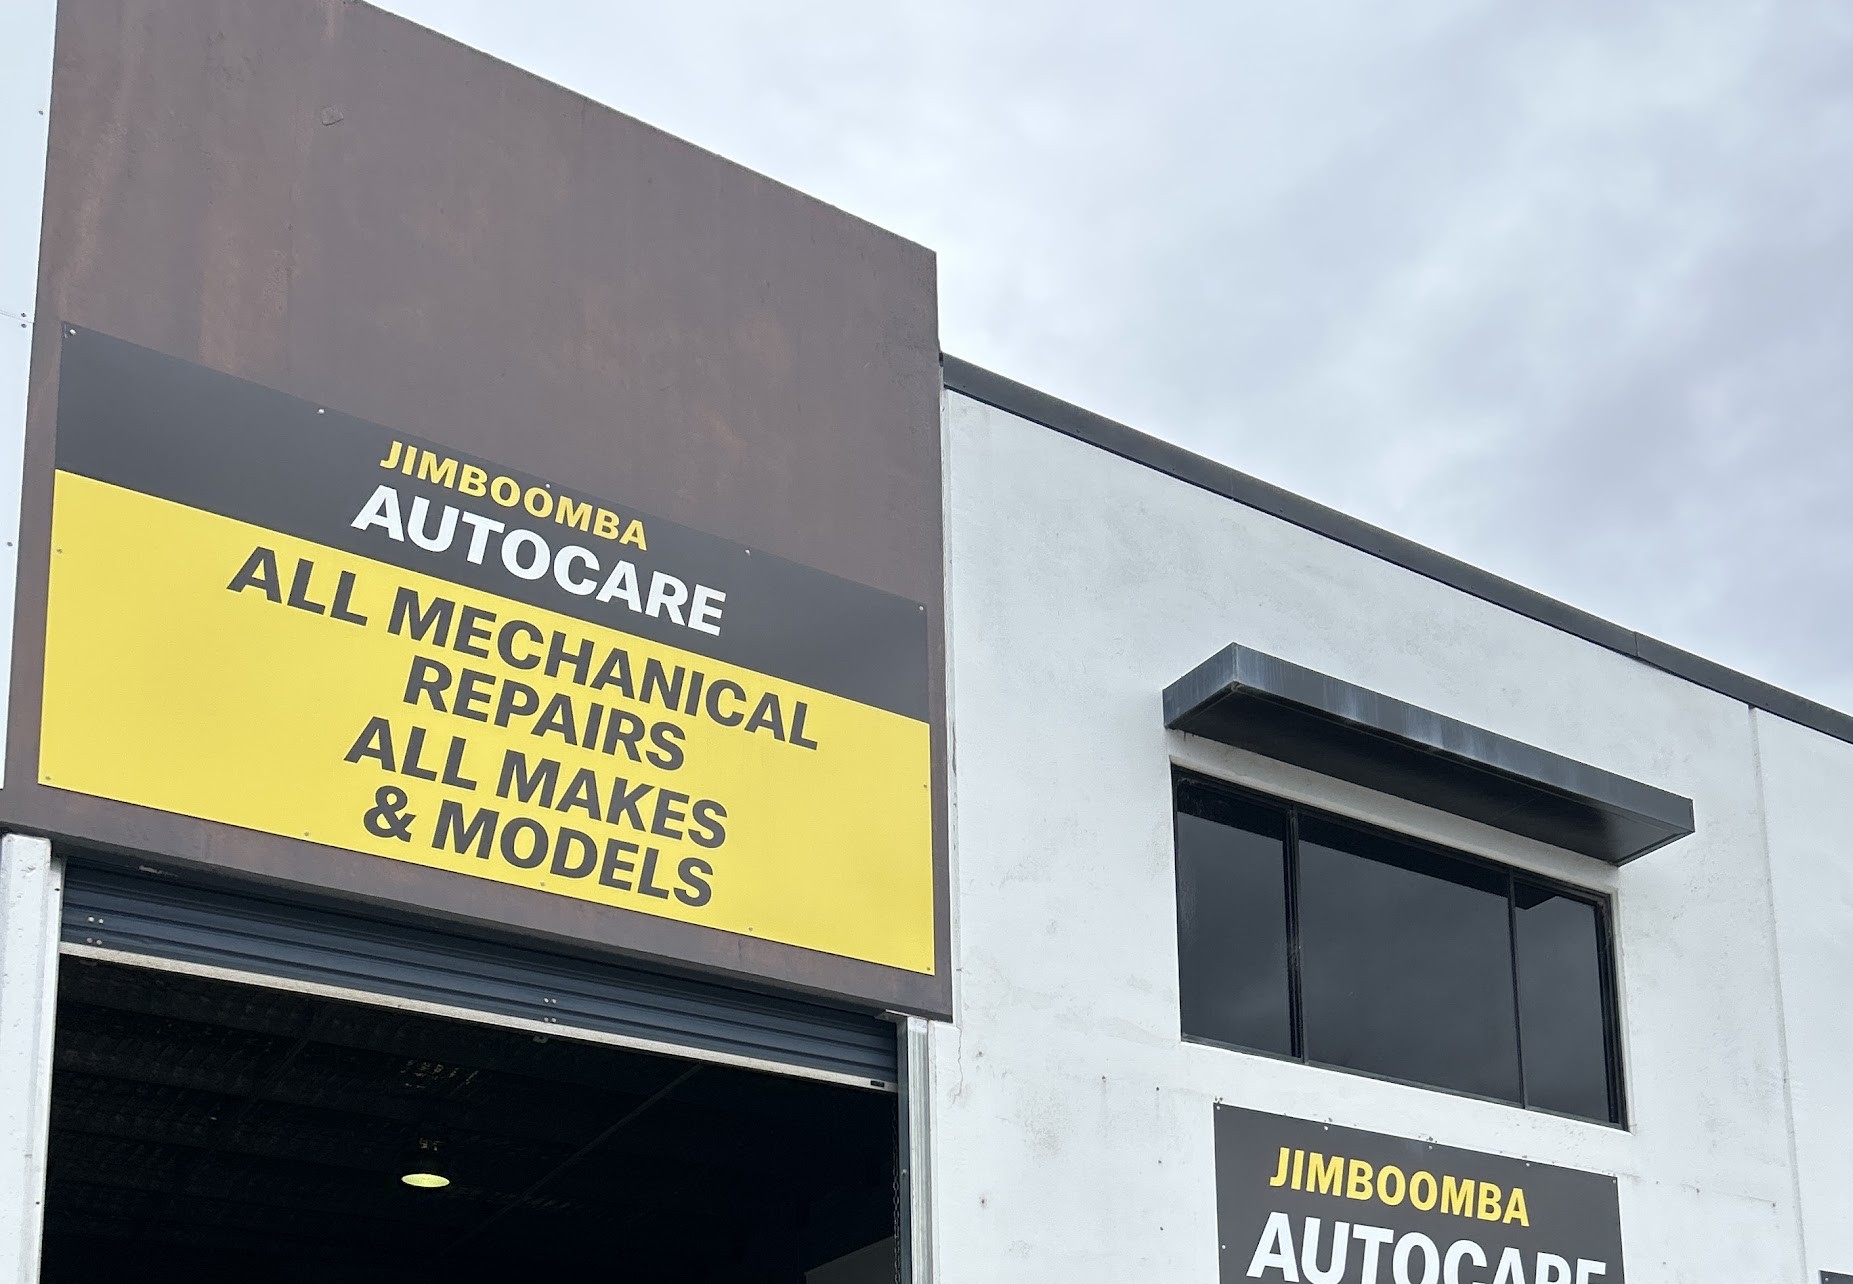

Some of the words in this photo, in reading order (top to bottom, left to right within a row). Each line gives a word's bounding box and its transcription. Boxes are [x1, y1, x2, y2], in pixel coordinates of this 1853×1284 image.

[379, 440, 649, 551] JIMBOOMBA
[350, 485, 727, 637] AUTOCARE
[226, 547, 368, 627] ALL
[387, 588, 819, 752] MECHANICAL
[402, 657, 685, 772] REPAIRS
[344, 717, 480, 789] ALL
[495, 753, 728, 850] MAKES
[363, 785, 414, 841] &
[432, 800, 715, 908] MODELS
[1269, 1147, 1531, 1227] JIMBOOMBA
